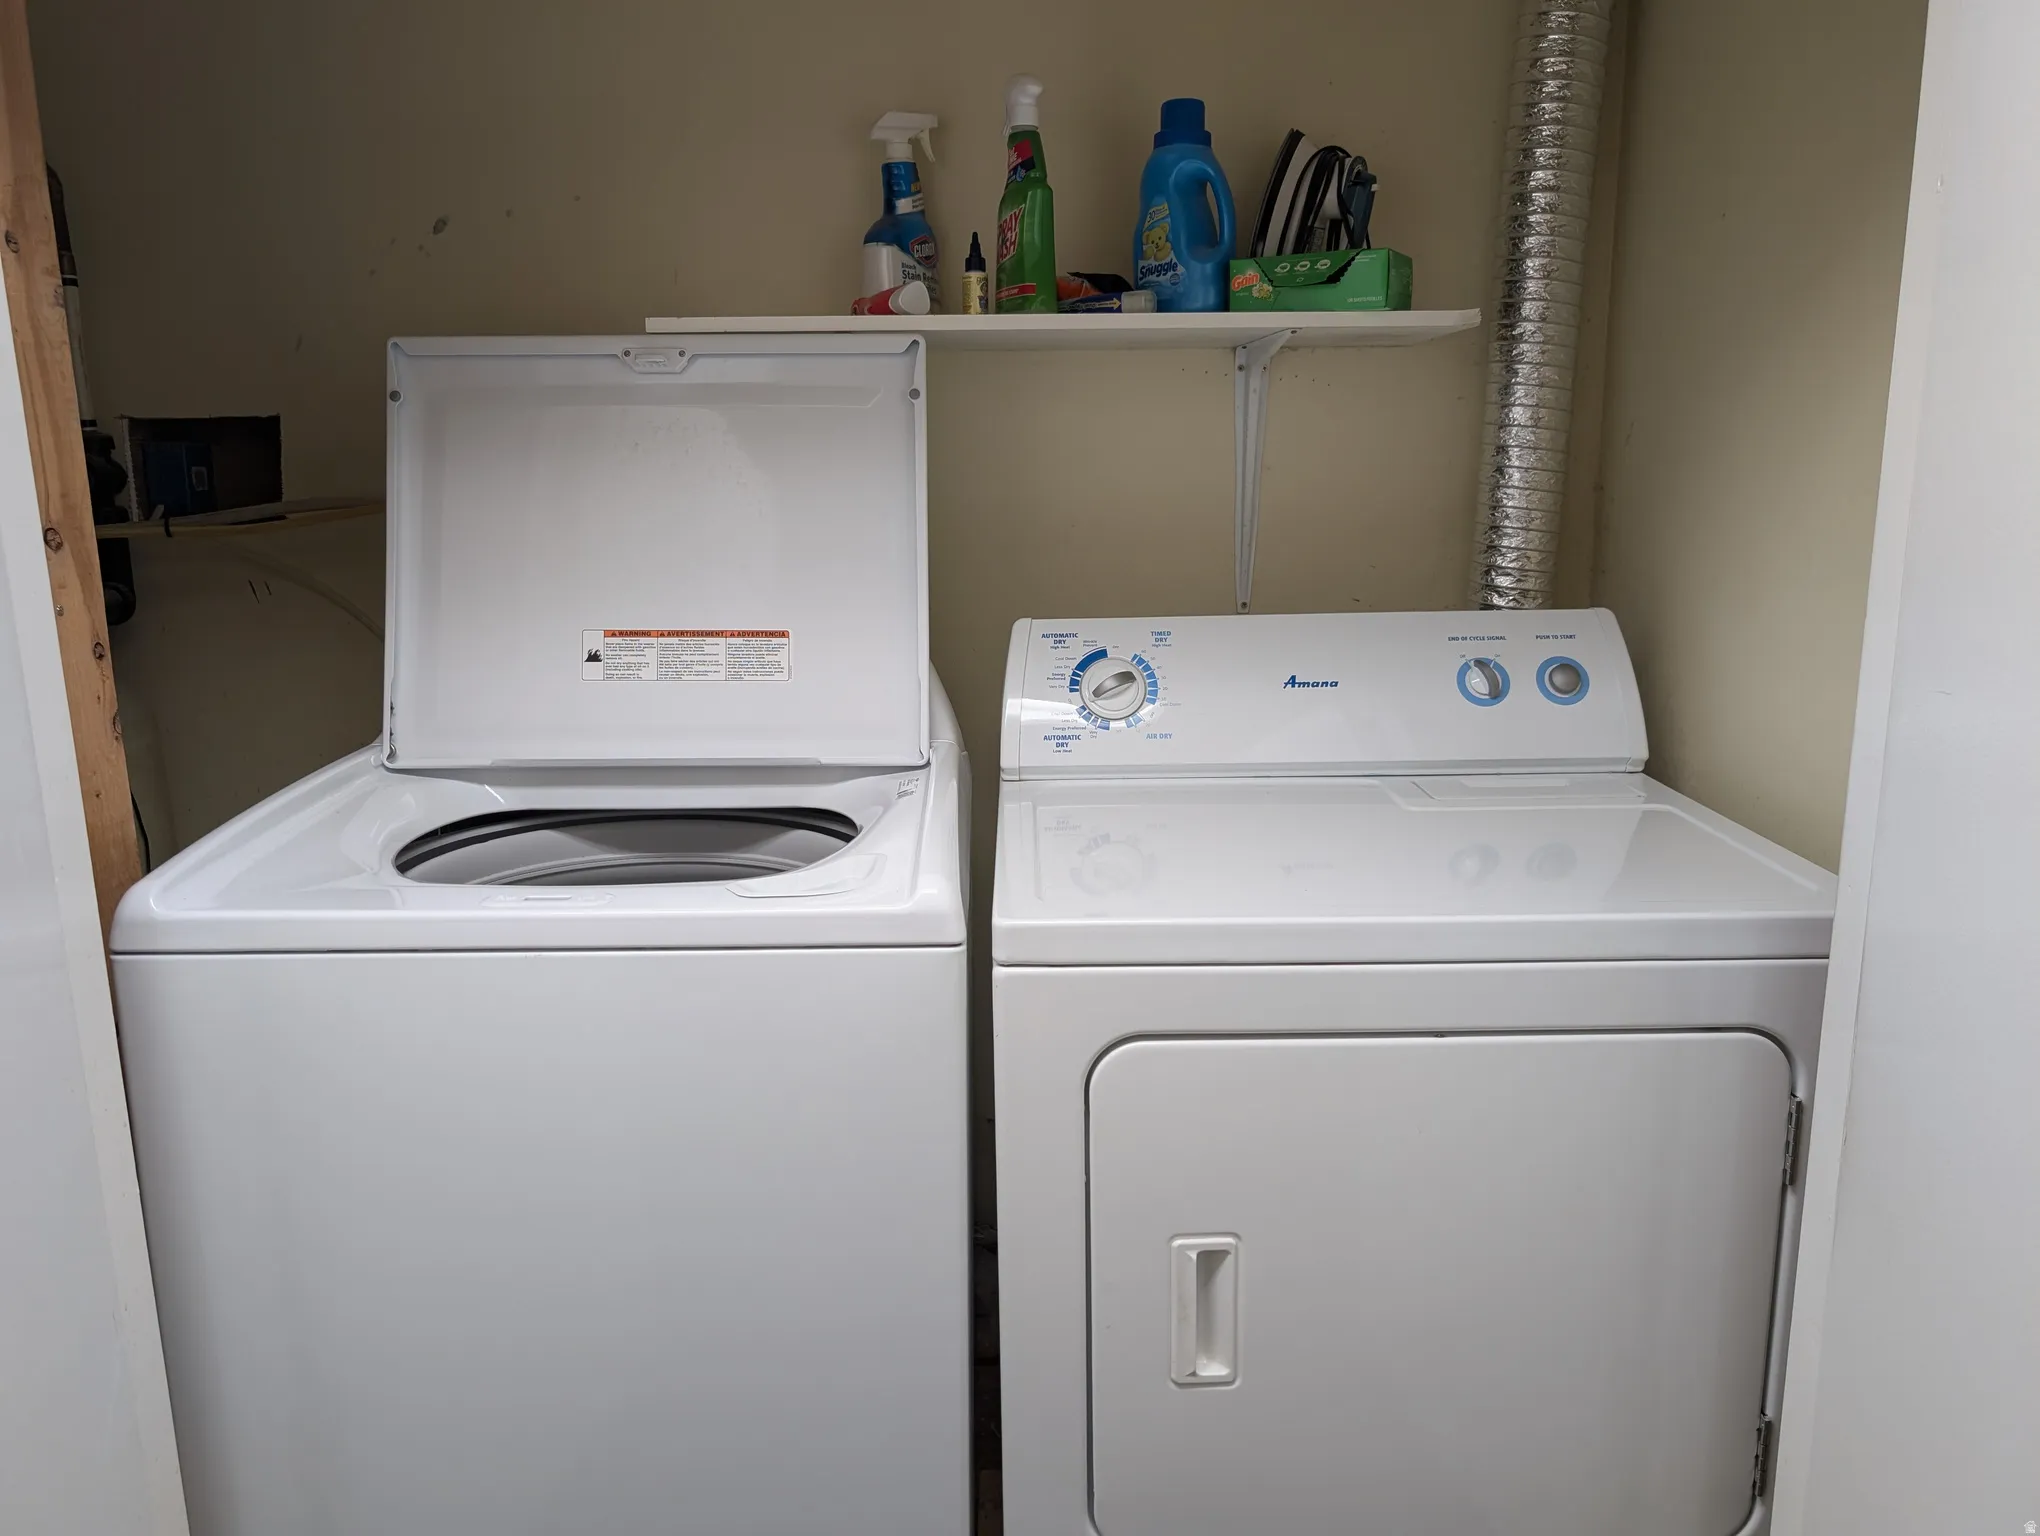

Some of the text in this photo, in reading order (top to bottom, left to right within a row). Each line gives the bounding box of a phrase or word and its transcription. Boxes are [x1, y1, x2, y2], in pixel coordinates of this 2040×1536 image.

[901, 269, 922, 282] Stain
[1138, 258, 1179, 281] Snuggle
[1231, 272, 1260, 291] Gain
[1282, 674, 1339, 690] Amana
[1159, 732, 1173, 740] DRY
